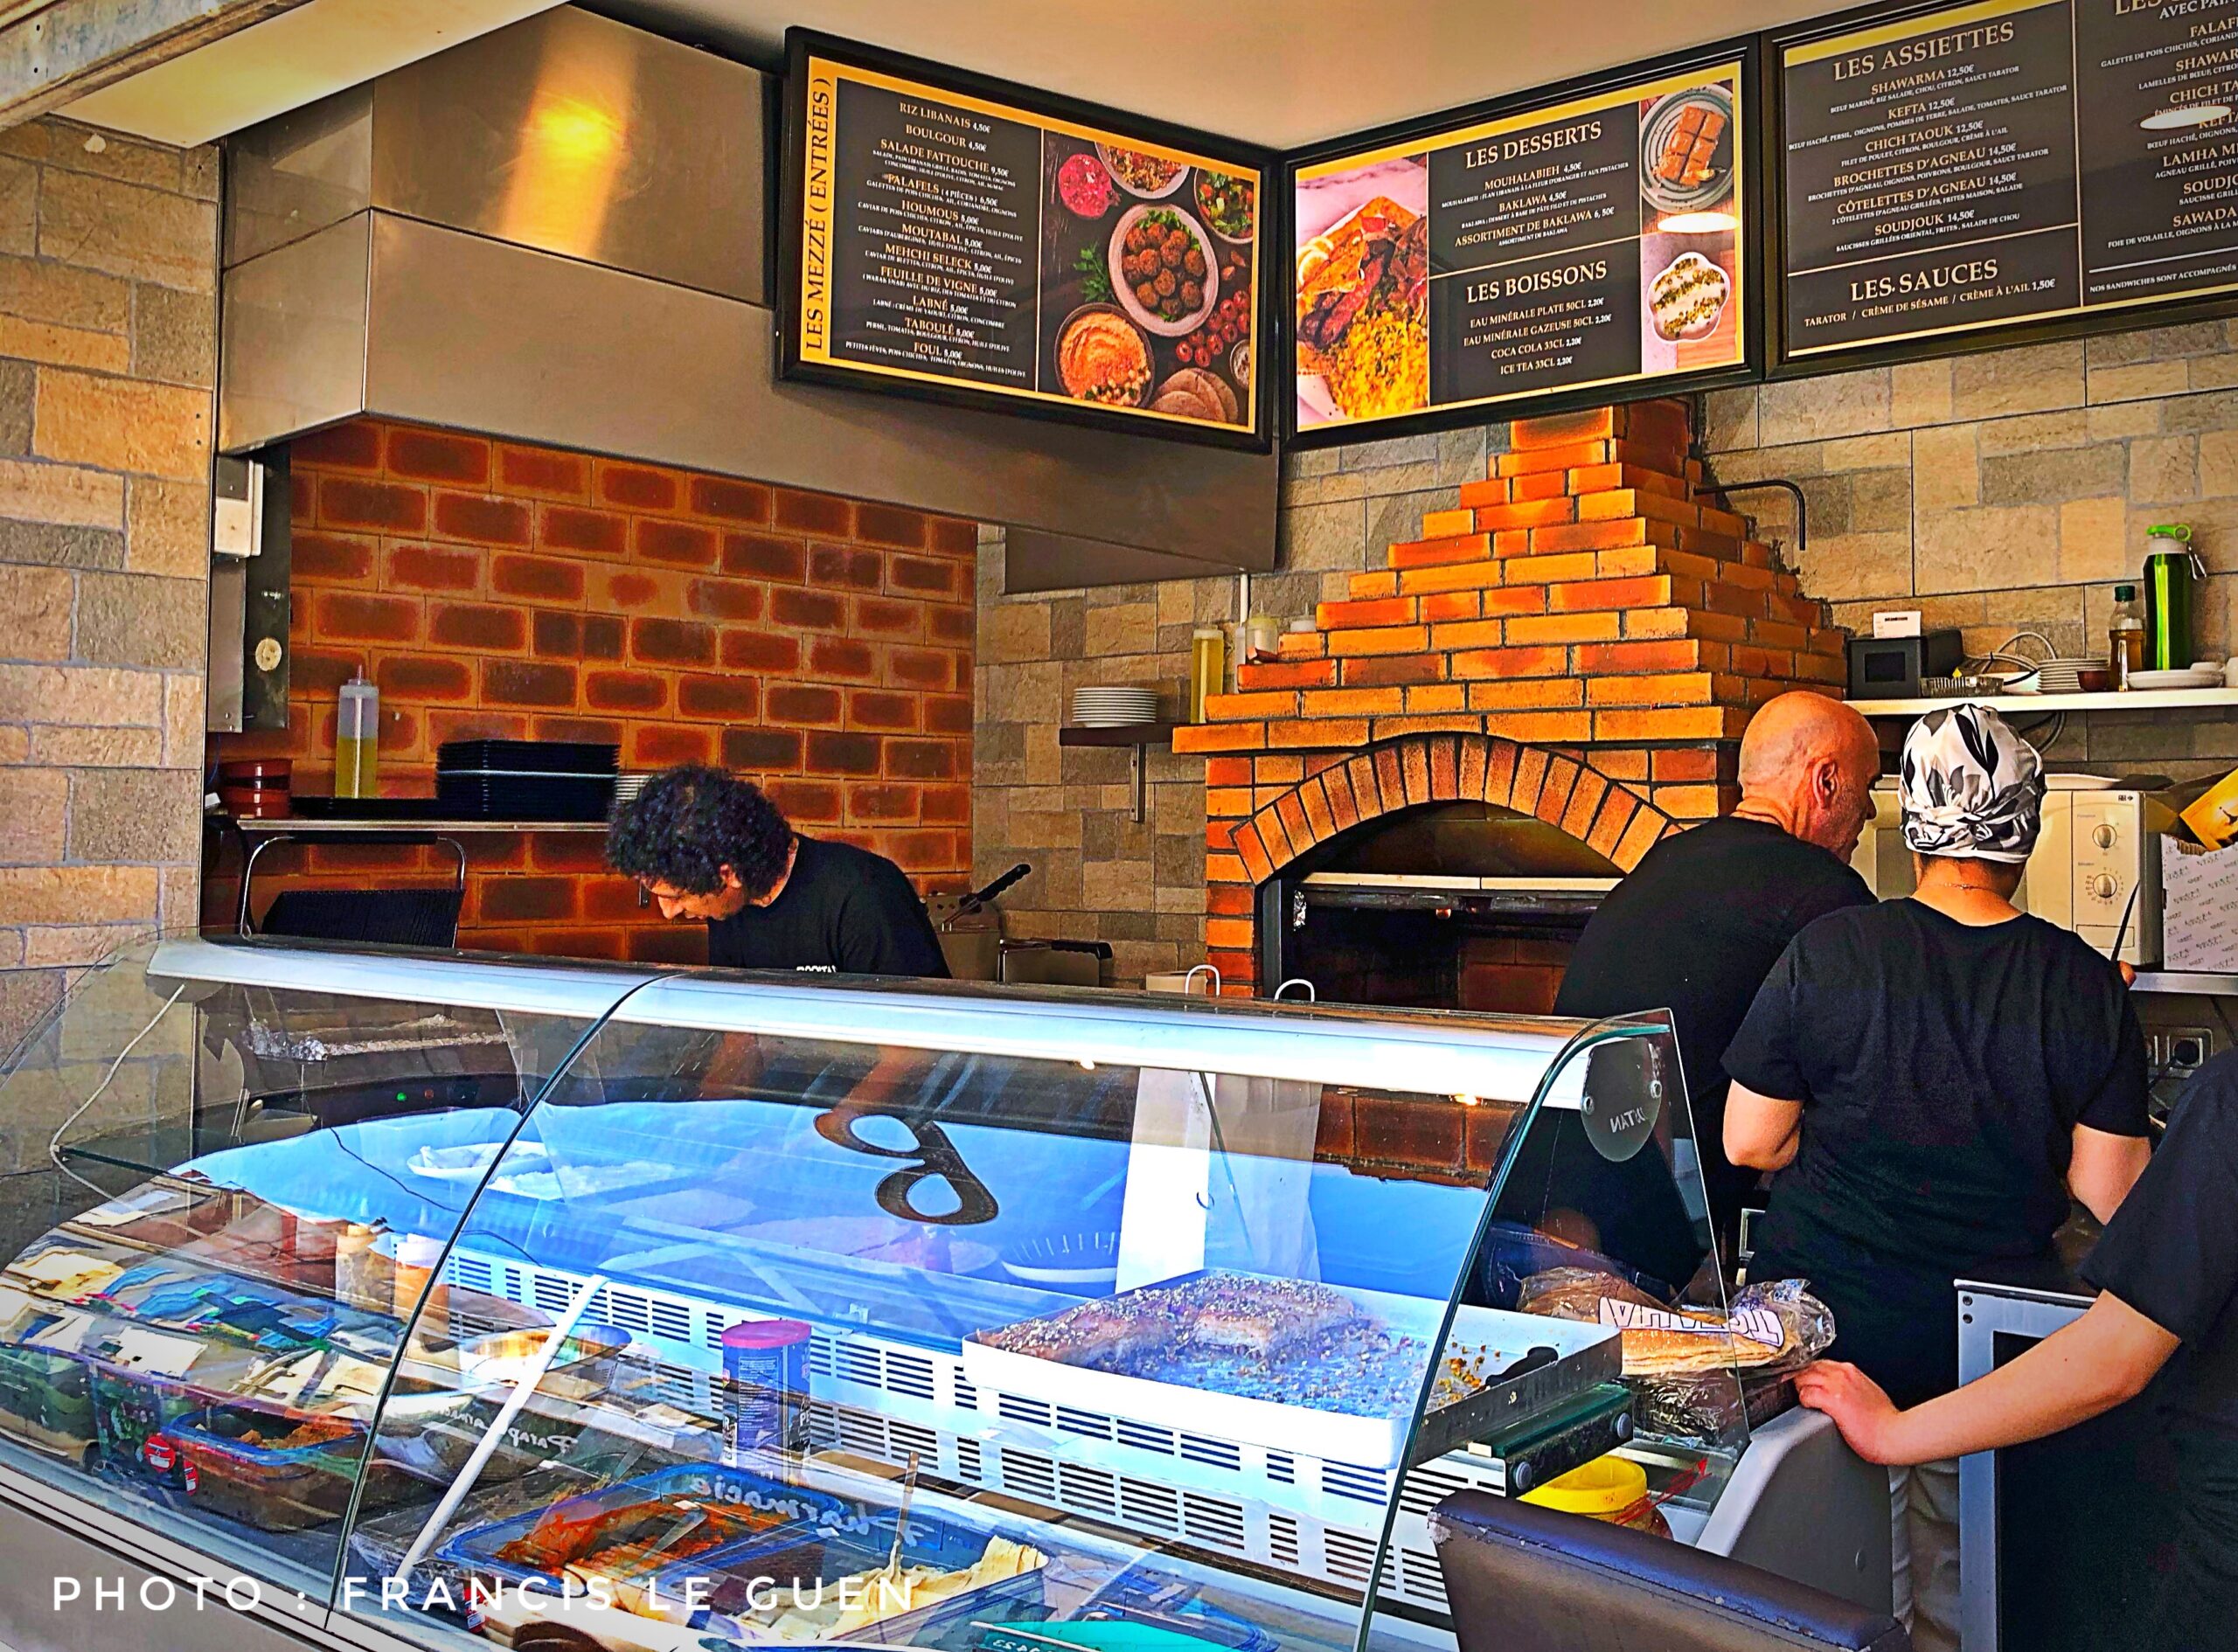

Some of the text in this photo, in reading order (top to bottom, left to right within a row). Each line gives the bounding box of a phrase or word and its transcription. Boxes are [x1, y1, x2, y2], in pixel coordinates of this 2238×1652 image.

[2158, 0, 2197, 19] AVEC
[1833, 20, 2013, 80] LES ASSIETTES
[1871, 64, 1974, 94] SHAWARMA 12,50€
[2169, 83, 2218, 104] CHICH
[900, 102, 917, 115] RIZ
[921, 107, 970, 128] LIBANAIS
[1888, 97, 1954, 119] KEFTA 12,50€
[906, 124, 966, 147] BOULGOUR
[1465, 120, 1601, 169] LES DESSERTS
[1865, 120, 1983, 152] CHICH TAOUK 12,50€
[880, 138, 924, 157] SALADE
[927, 149, 989, 172] FATTOUCHE
[1833, 142, 2016, 187] BROCHETTES D'AGNEAU 14,50€
[2163, 146, 2217, 167] LAMHA
[1484, 161, 1581, 191] MOUHALABIEH 4,50€
[1499, 191, 1567, 212] BAKLAWA 4,50€
[1837, 171, 2016, 214] CÔTELETTES D'AGNEAU 14,50€
[2179, 192, 2215, 205] SAUCISSE
[803, 88, 829, 351] LES MEZZÉ ENTRÉES
[901, 199, 958, 221] HOUMOUS
[1874, 209, 1974, 238] SOUDJOUK 14,50€
[2173, 205, 2236, 226] SAWADA
[1455, 209, 1591, 246] ASSORTIMENT DE BAKLAWA
[885, 243, 929, 261] MEHCHI
[932, 253, 972, 269] SELECK
[880, 265, 923, 283] FEUILLE
[926, 274, 941, 286] DE
[942, 277, 977, 294] VIGNE
[1467, 260, 1606, 303] LES BOISSONS
[1899, 258, 1998, 294] SAUCES
[913, 292, 948, 311] LABNÉ
[1470, 299, 1586, 328] EAU MINÉRALE PLATE 50CL
[1804, 312, 1846, 327] TARATOR
[1861, 302, 1894, 317] CRÈME
[1895, 302, 1908, 312] DE
[1910, 294, 1948, 309] SÉSAME
[1959, 286, 1993, 302] CRÈME
[2005, 282, 2030, 295] L'AIL
[2032, 278, 2055, 291] 1,50€
[904, 315, 954, 336] TABOULÉ
[1463, 315, 1594, 346] EAU MINÉRALE GAZEUSE 50CL
[914, 342, 941, 356] FOUL
[1491, 337, 1565, 358] COCA COLA 33CL
[1500, 357, 1554, 374] ICE TEA 33CL
